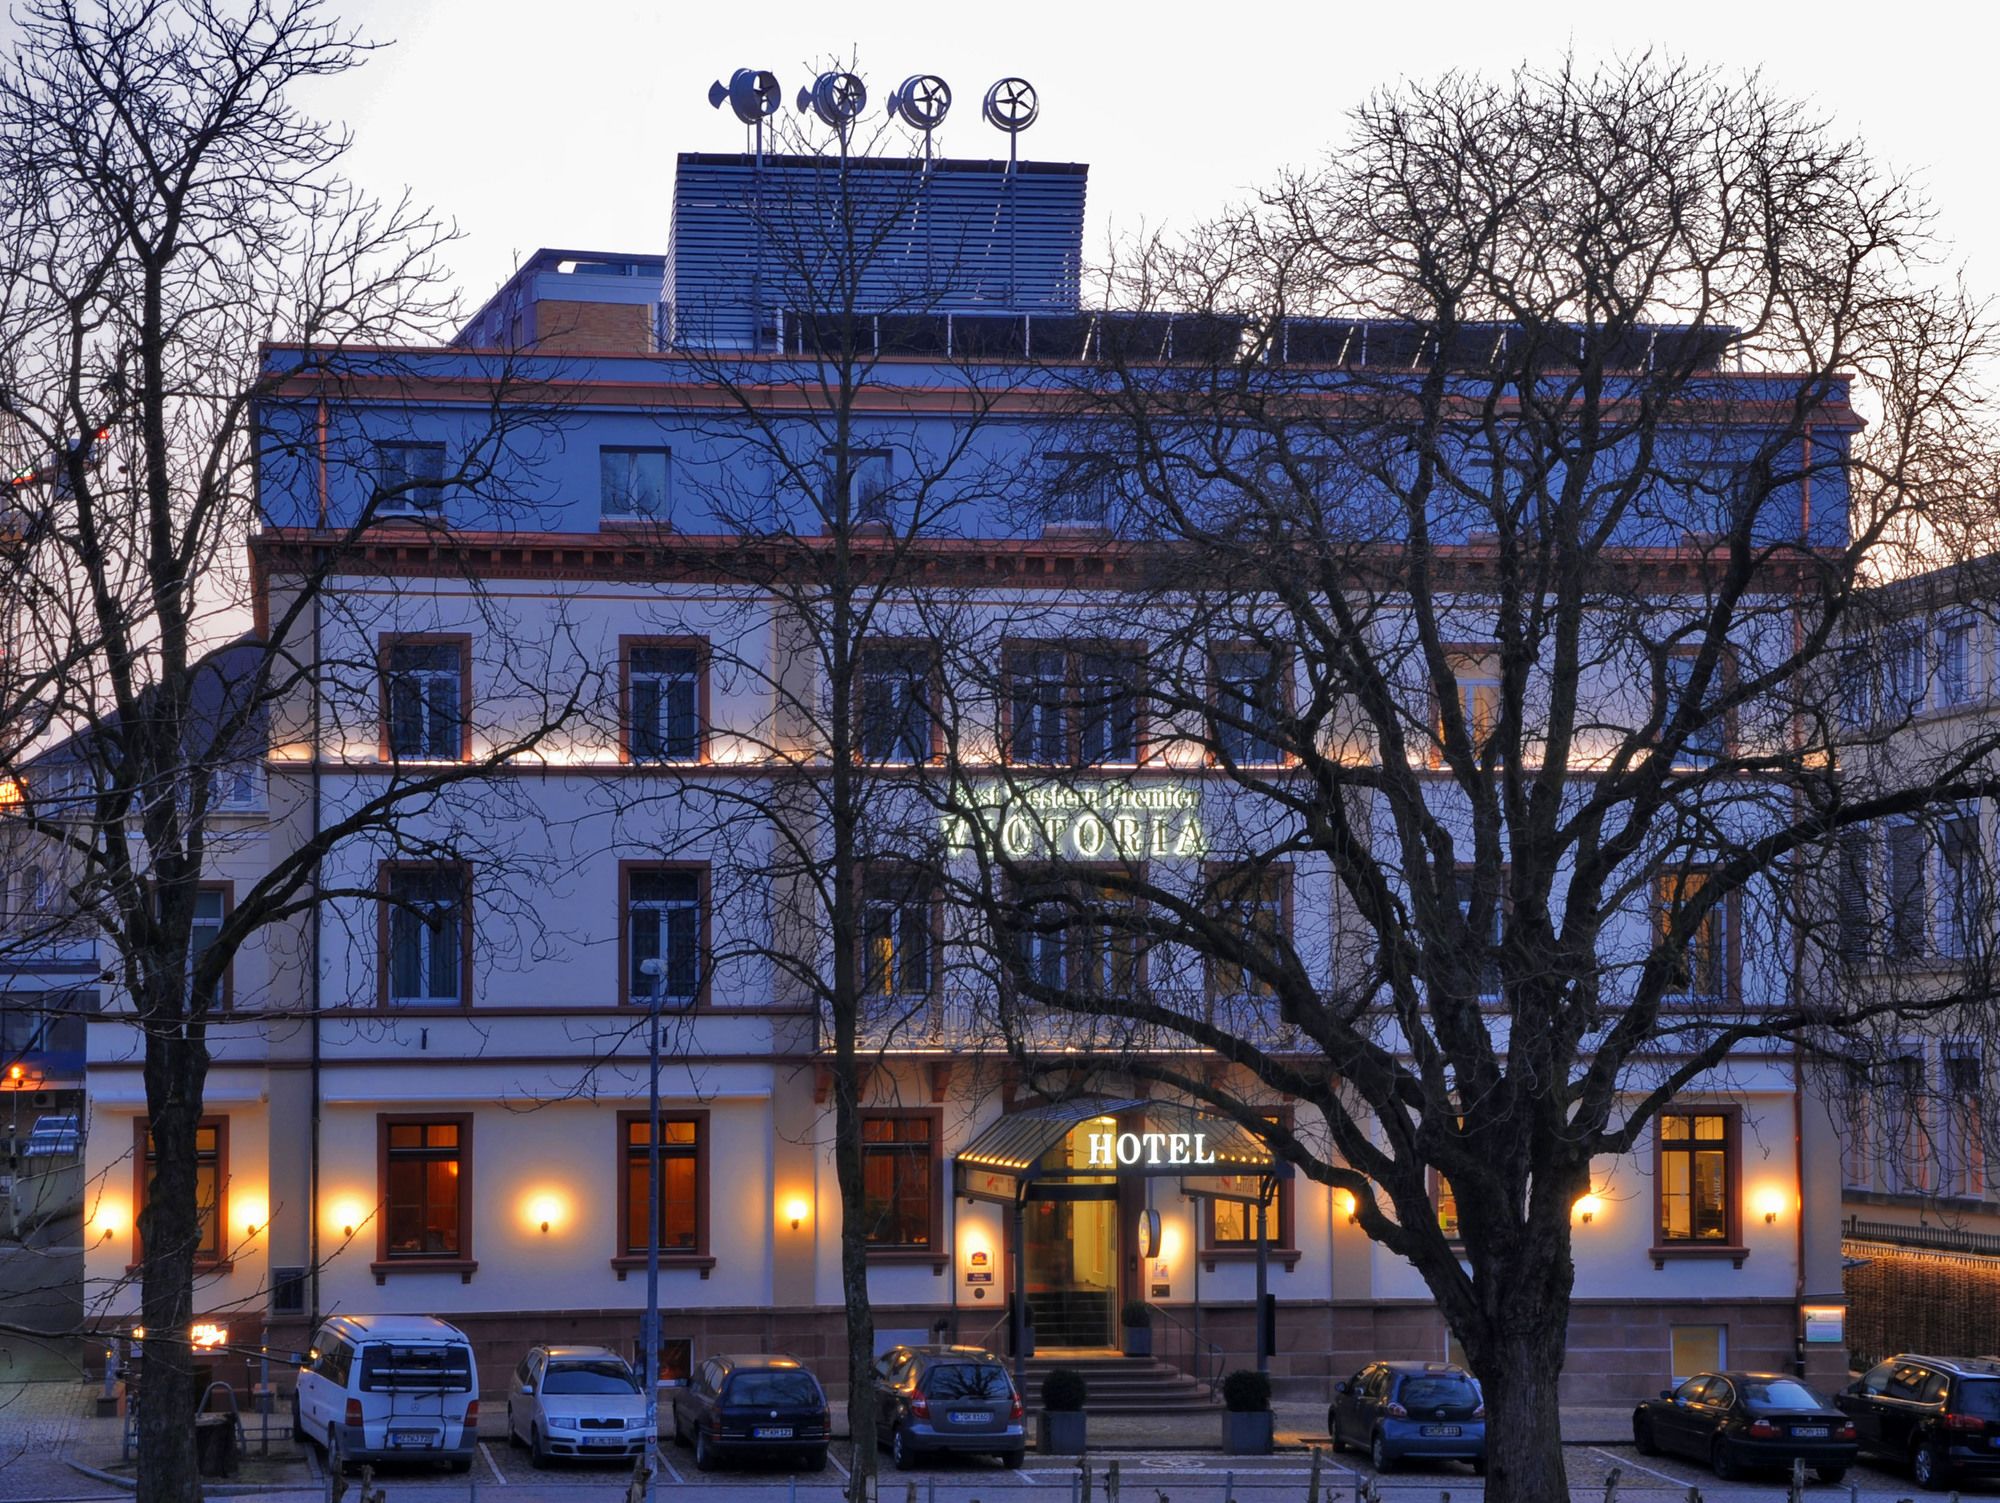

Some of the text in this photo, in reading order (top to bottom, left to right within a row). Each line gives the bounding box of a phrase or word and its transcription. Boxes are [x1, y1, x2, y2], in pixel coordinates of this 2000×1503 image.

[953, 781, 1198, 808] st estern Premier
[1089, 1133, 1215, 1164] HOTEL
